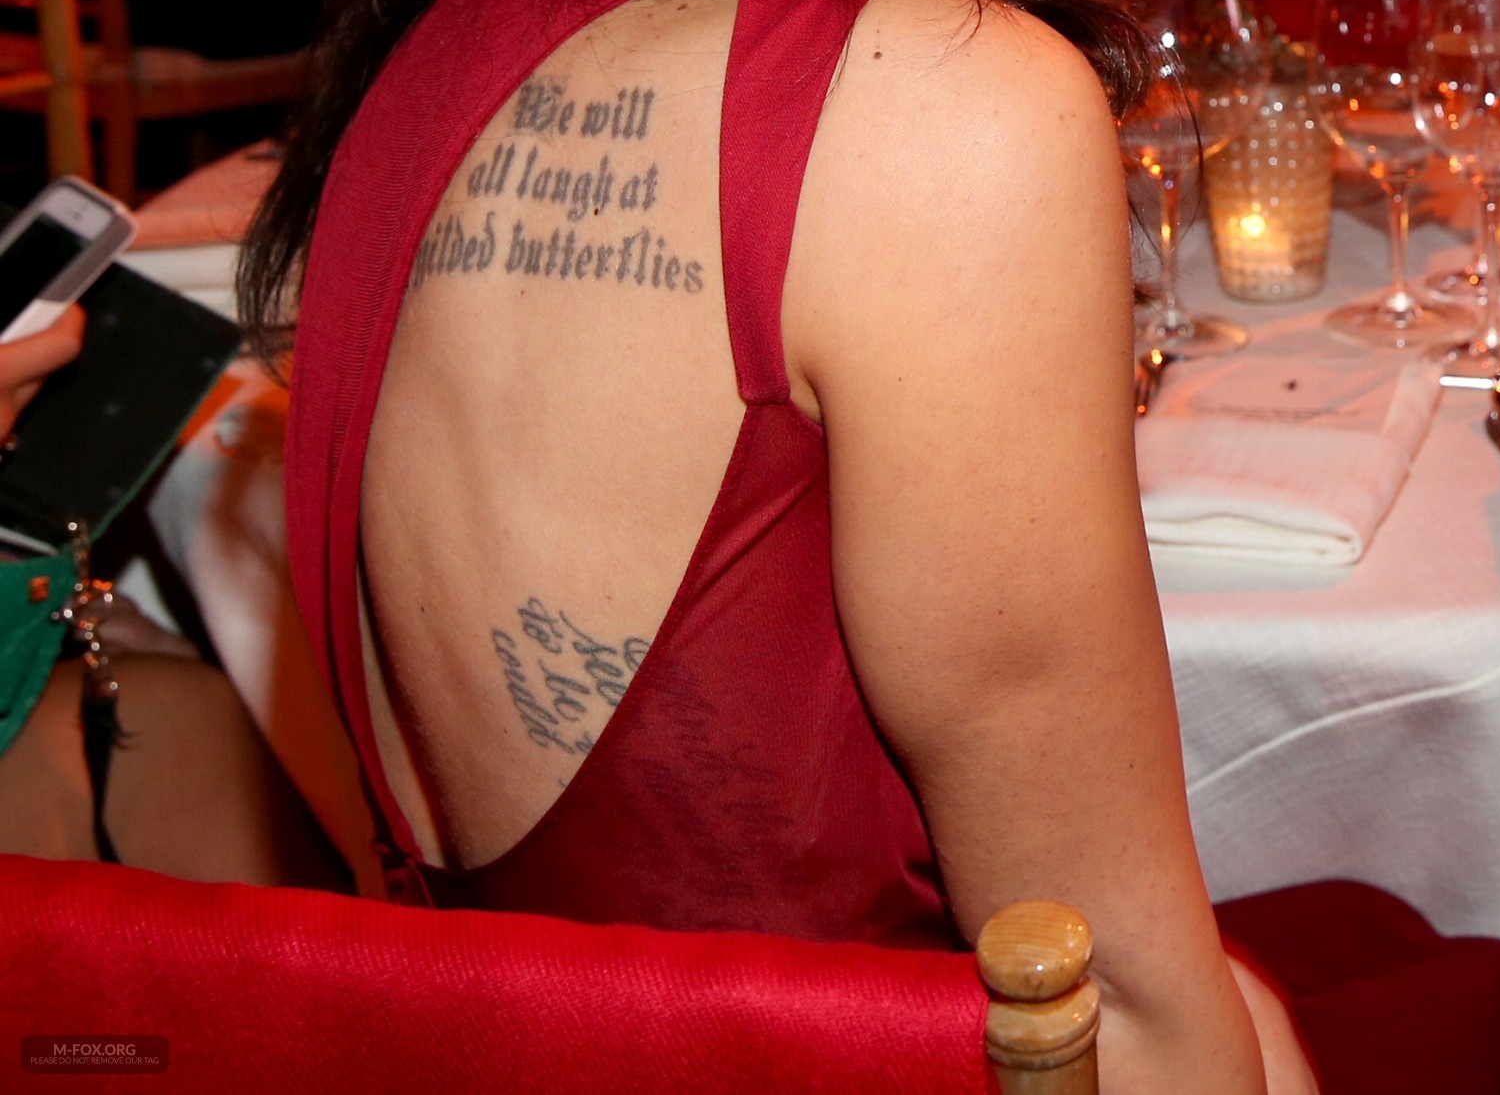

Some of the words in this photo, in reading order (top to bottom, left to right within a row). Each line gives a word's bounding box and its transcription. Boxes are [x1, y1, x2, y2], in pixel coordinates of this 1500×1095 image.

[513, 75, 575, 141] We
[580, 85, 655, 141] will
[467, 140, 517, 198] all
[517, 145, 614, 221] laugh
[618, 161, 659, 211] at
[505, 219, 705, 293] butterflies
